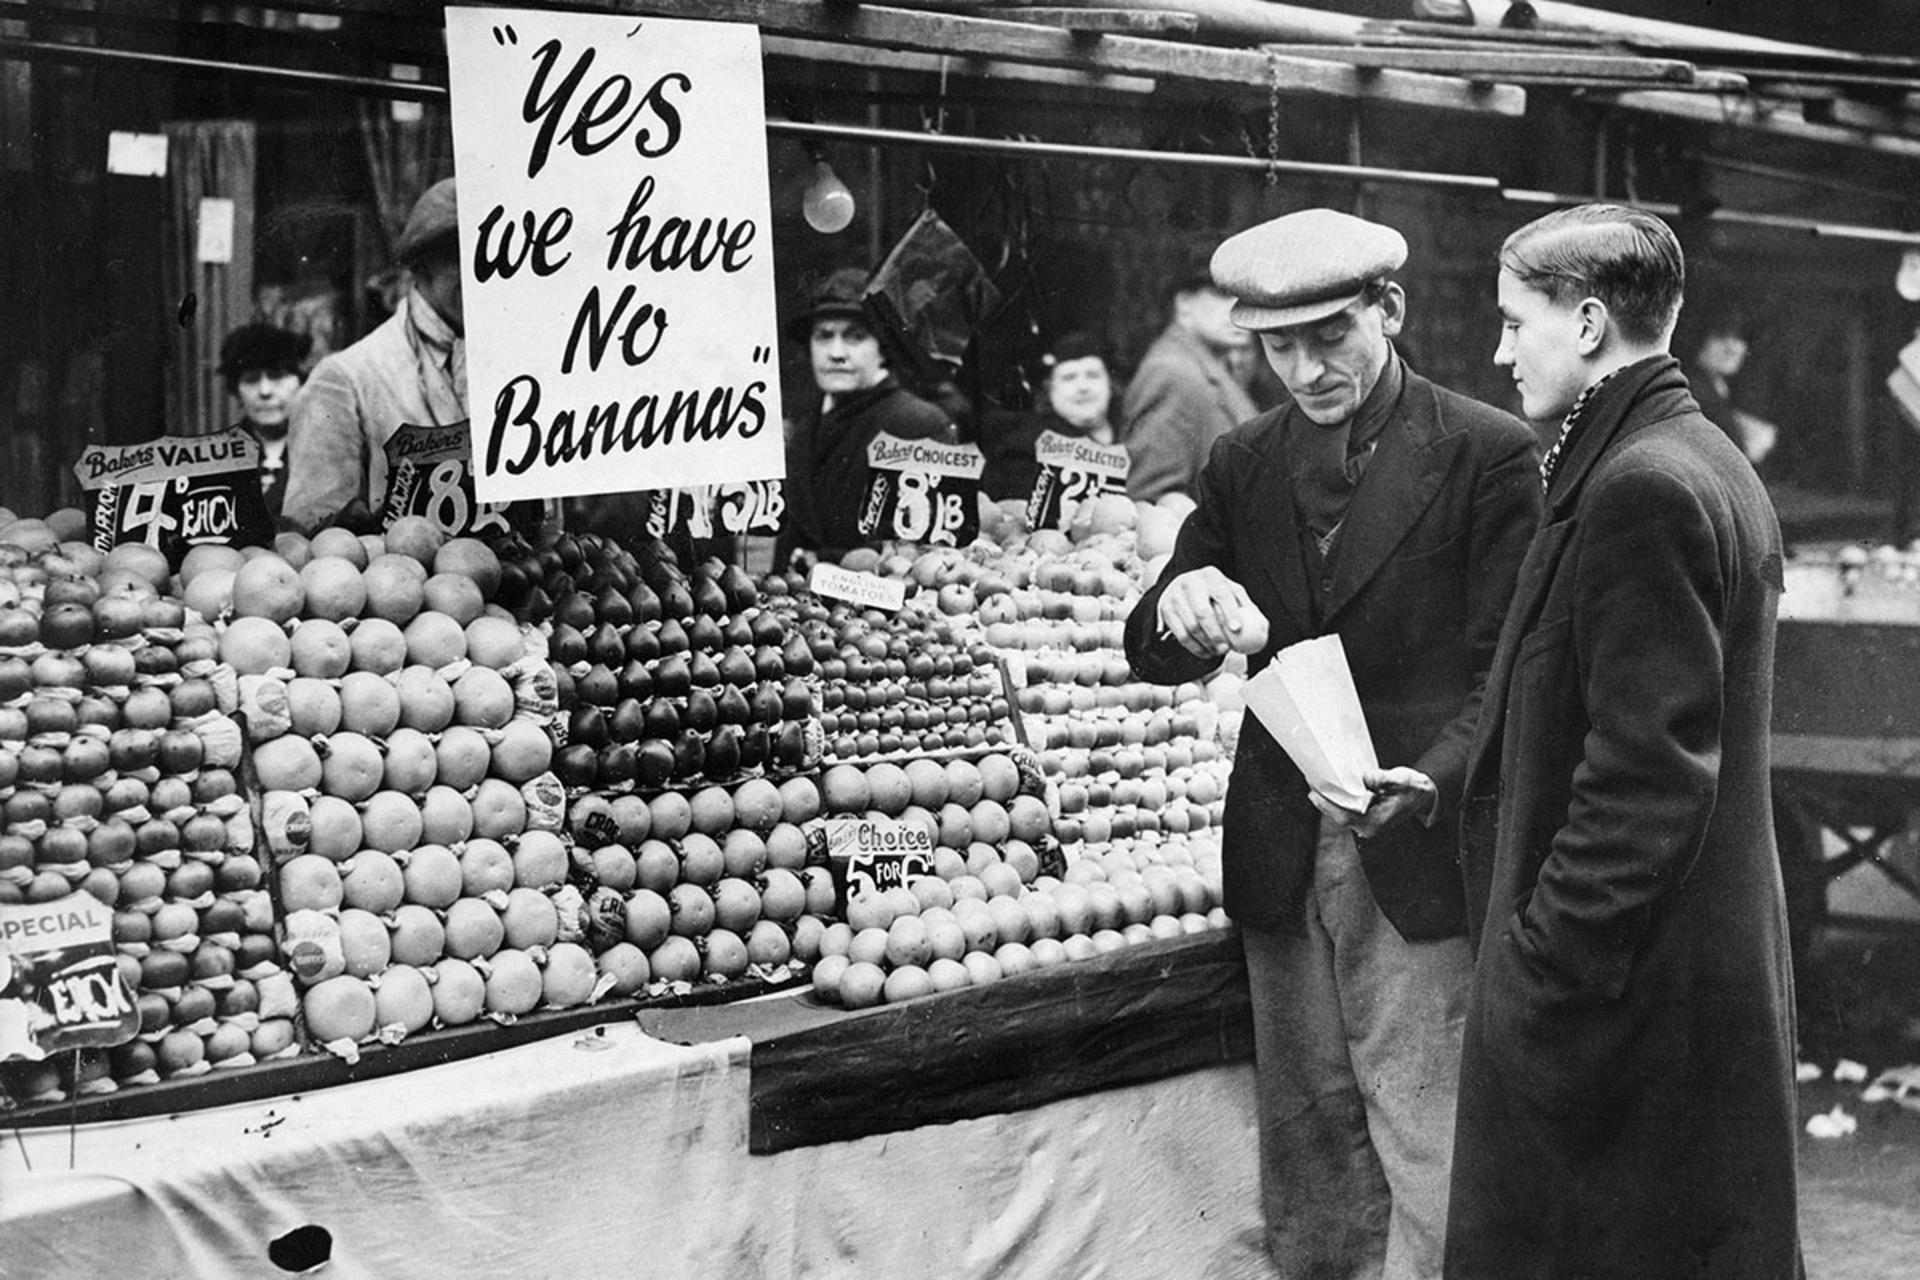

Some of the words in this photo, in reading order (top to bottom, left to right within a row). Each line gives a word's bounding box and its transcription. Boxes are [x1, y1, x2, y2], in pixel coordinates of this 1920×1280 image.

[474, 204, 573, 283] we
[606, 175, 756, 273] have
[561, 284, 668, 374] No
[157, 440, 246, 467] VALUE
[913, 446, 979, 468] CHOICEST
[1075, 446, 1127, 470] SELECTED
[182, 495, 238, 538] EACH
[875, 860, 903, 884] FOR
[0, 909, 101, 940] PECIAL
